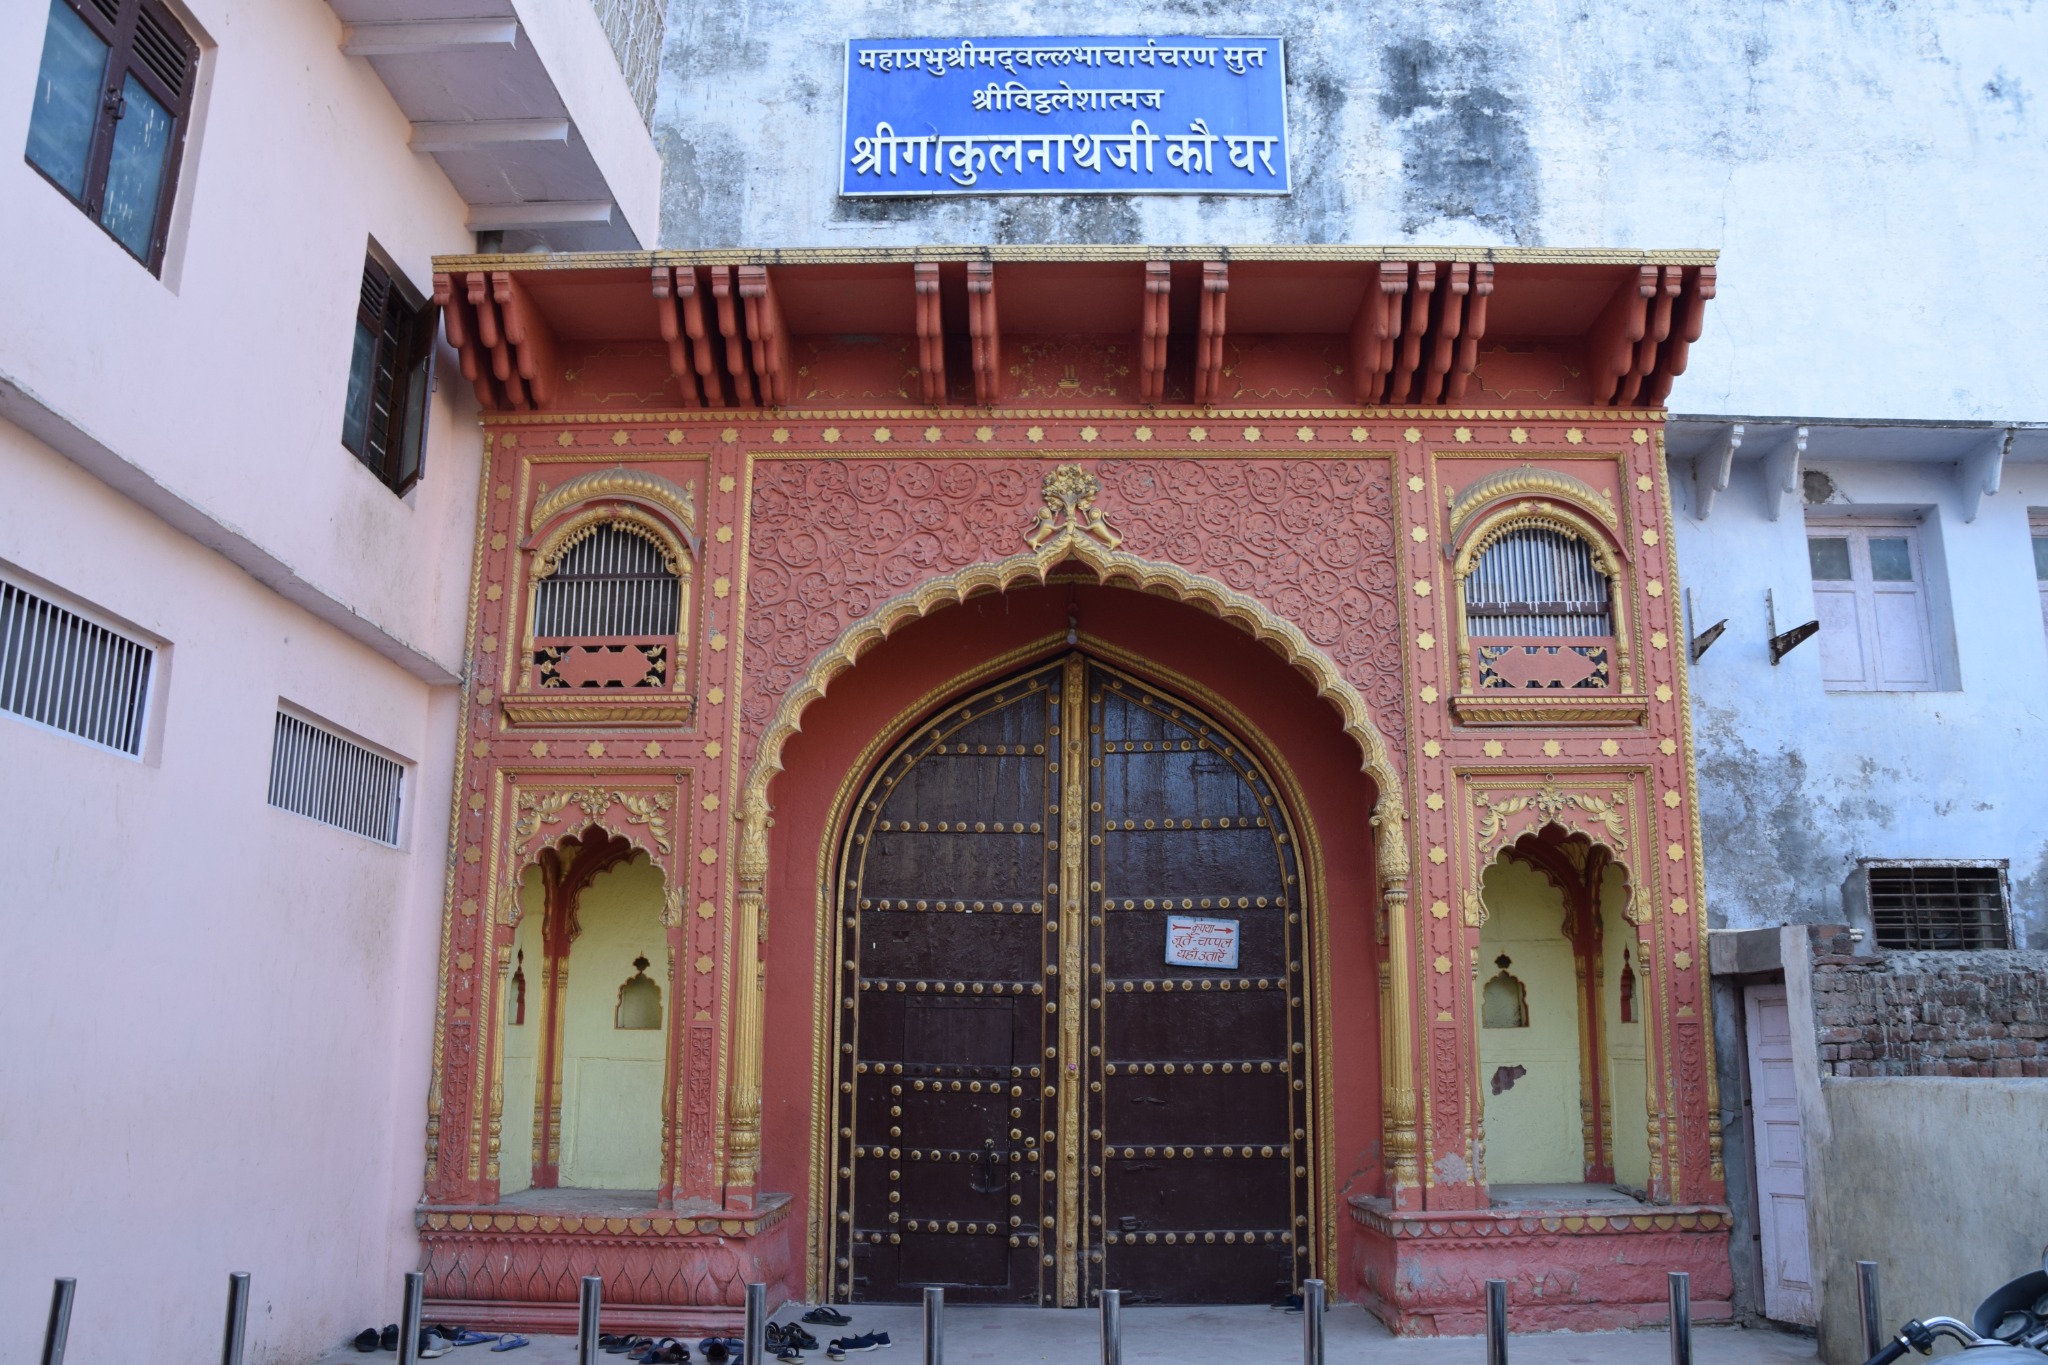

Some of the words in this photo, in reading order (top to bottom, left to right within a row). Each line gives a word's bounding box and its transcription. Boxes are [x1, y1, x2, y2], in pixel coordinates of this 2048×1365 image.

[1223, 47, 1267, 74] सुत
[1164, 117, 1219, 174] कौ
[1222, 135, 1279, 176] घर
[1198, 948, 1227, 963] उतारें
